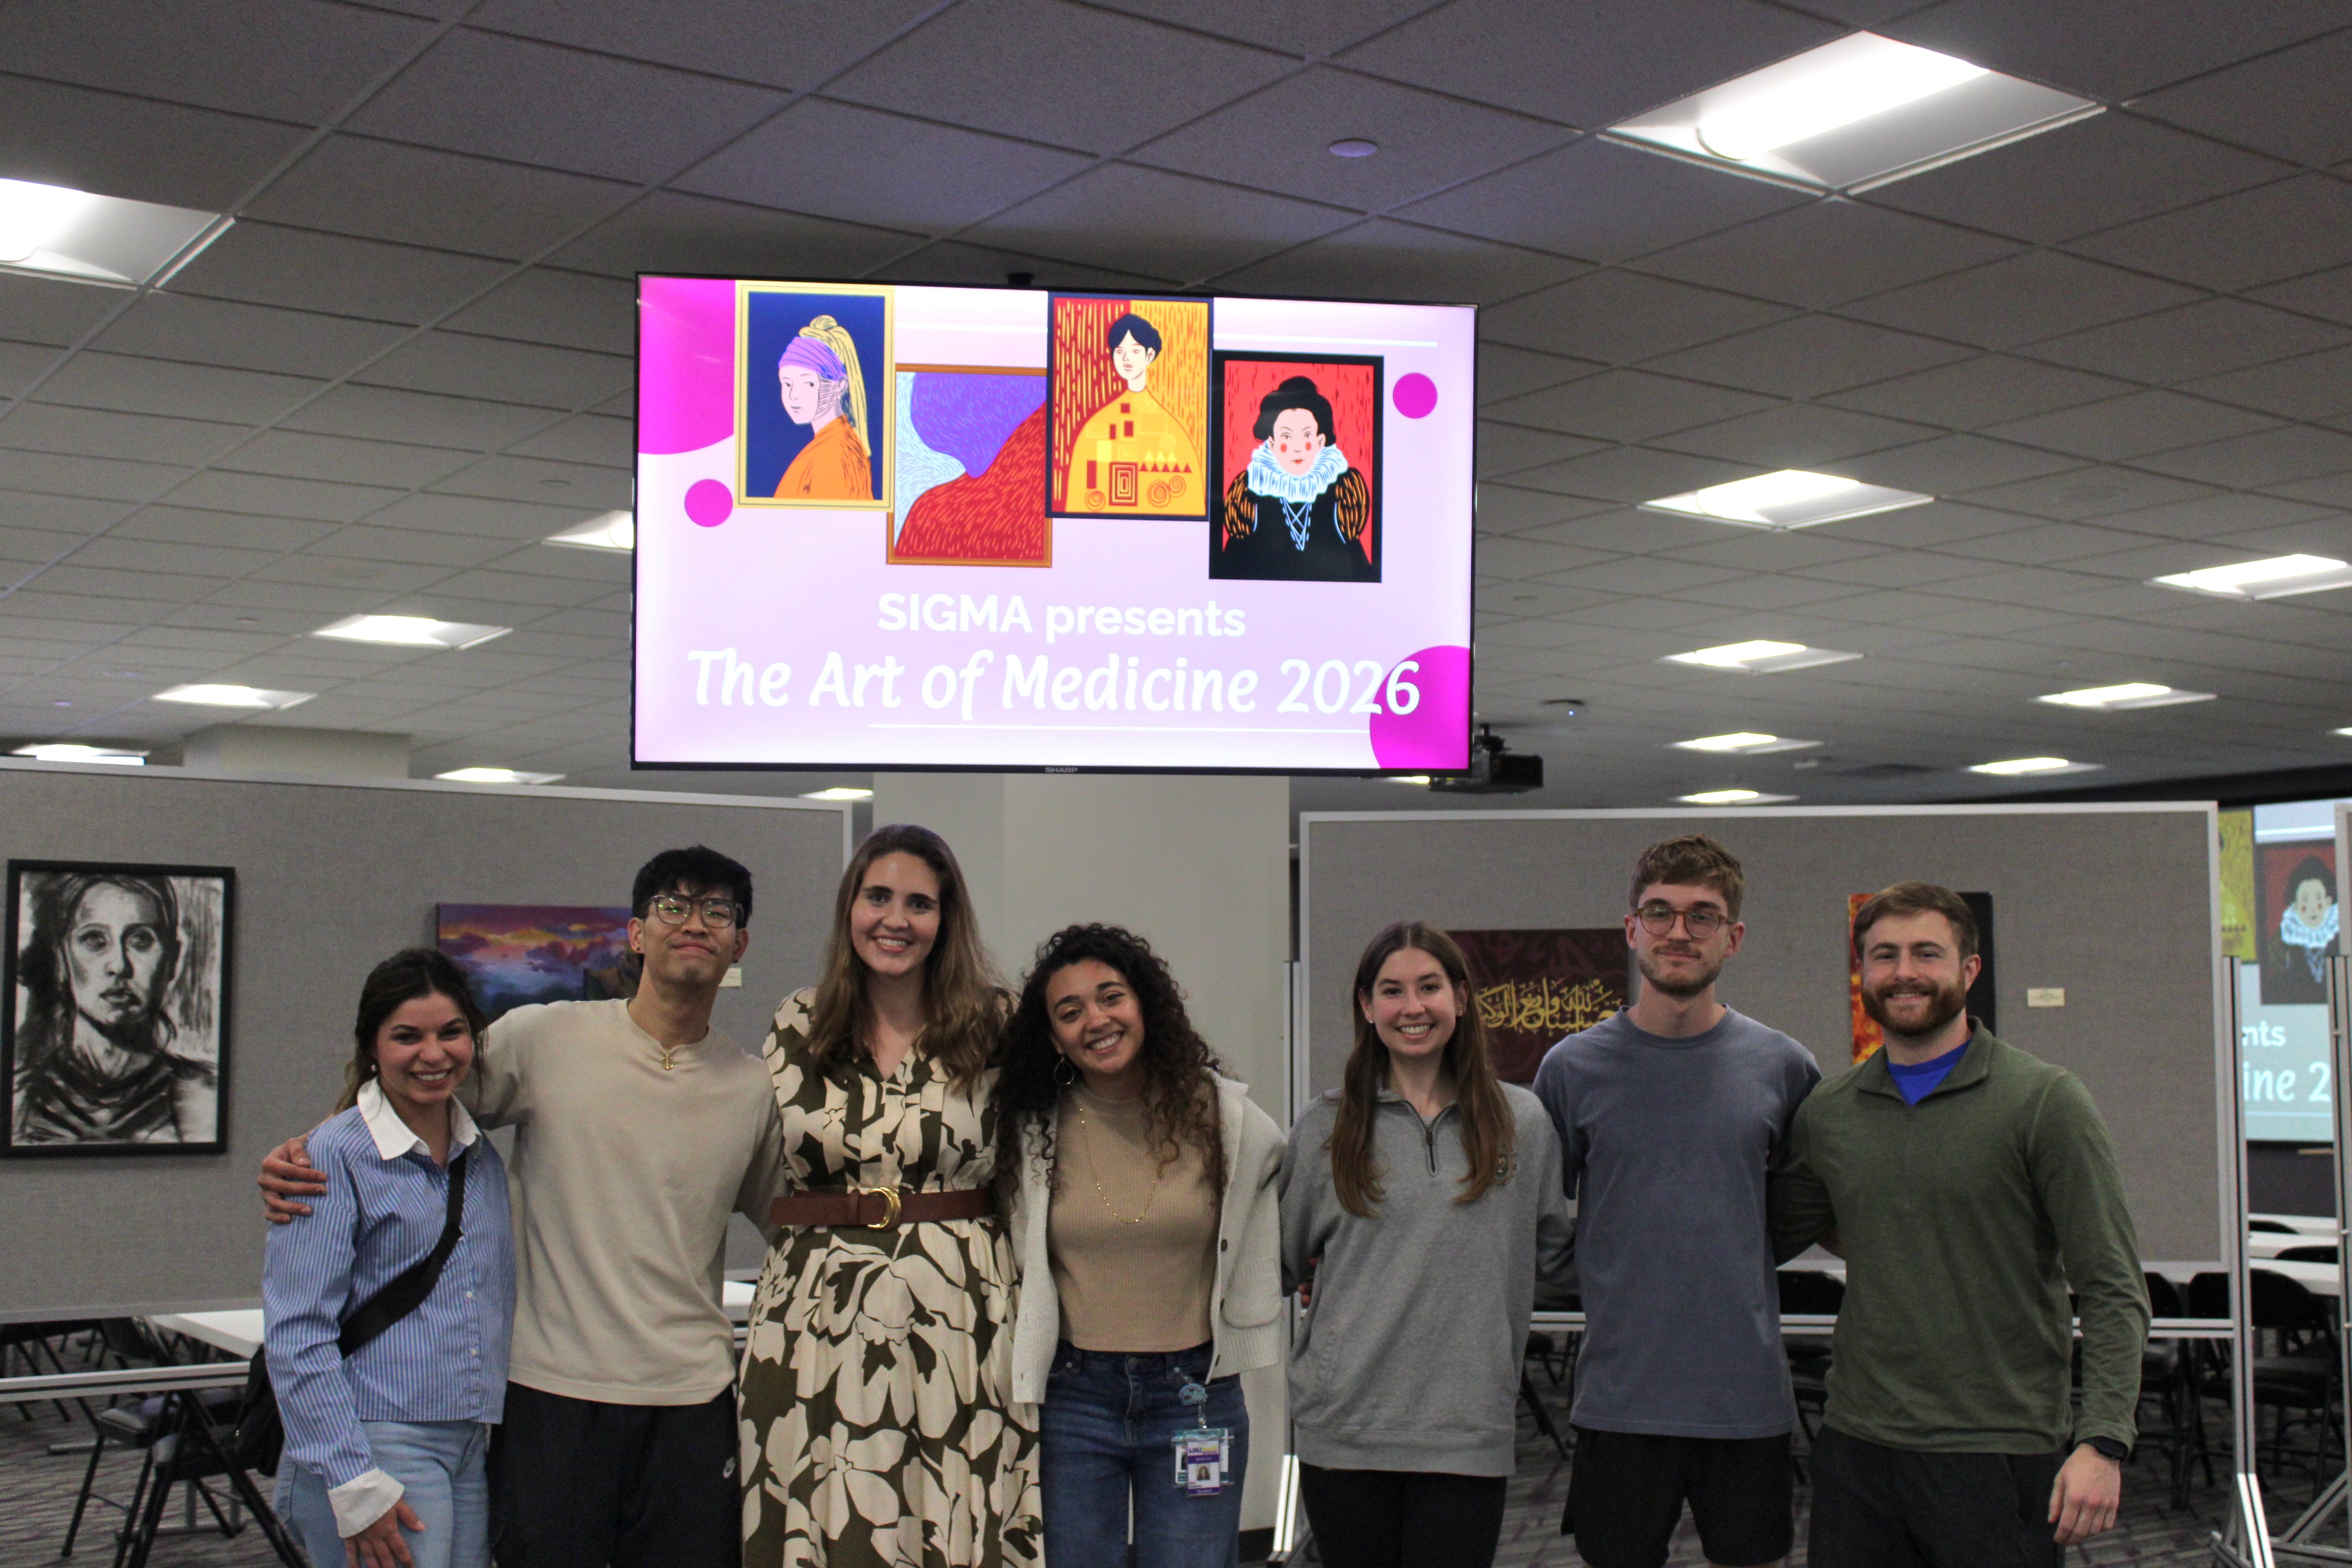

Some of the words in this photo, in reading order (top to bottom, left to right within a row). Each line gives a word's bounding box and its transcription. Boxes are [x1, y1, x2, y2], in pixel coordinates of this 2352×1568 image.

[877, 592, 1033, 633] SIGMA
[1046, 601, 1247, 643] presents
[687, 647, 792, 707] The
[808, 651, 906, 708] Art
[922, 649, 995, 721] of
[1002, 653, 1259, 713] Medicine
[1276, 658, 1421, 716] 2026
